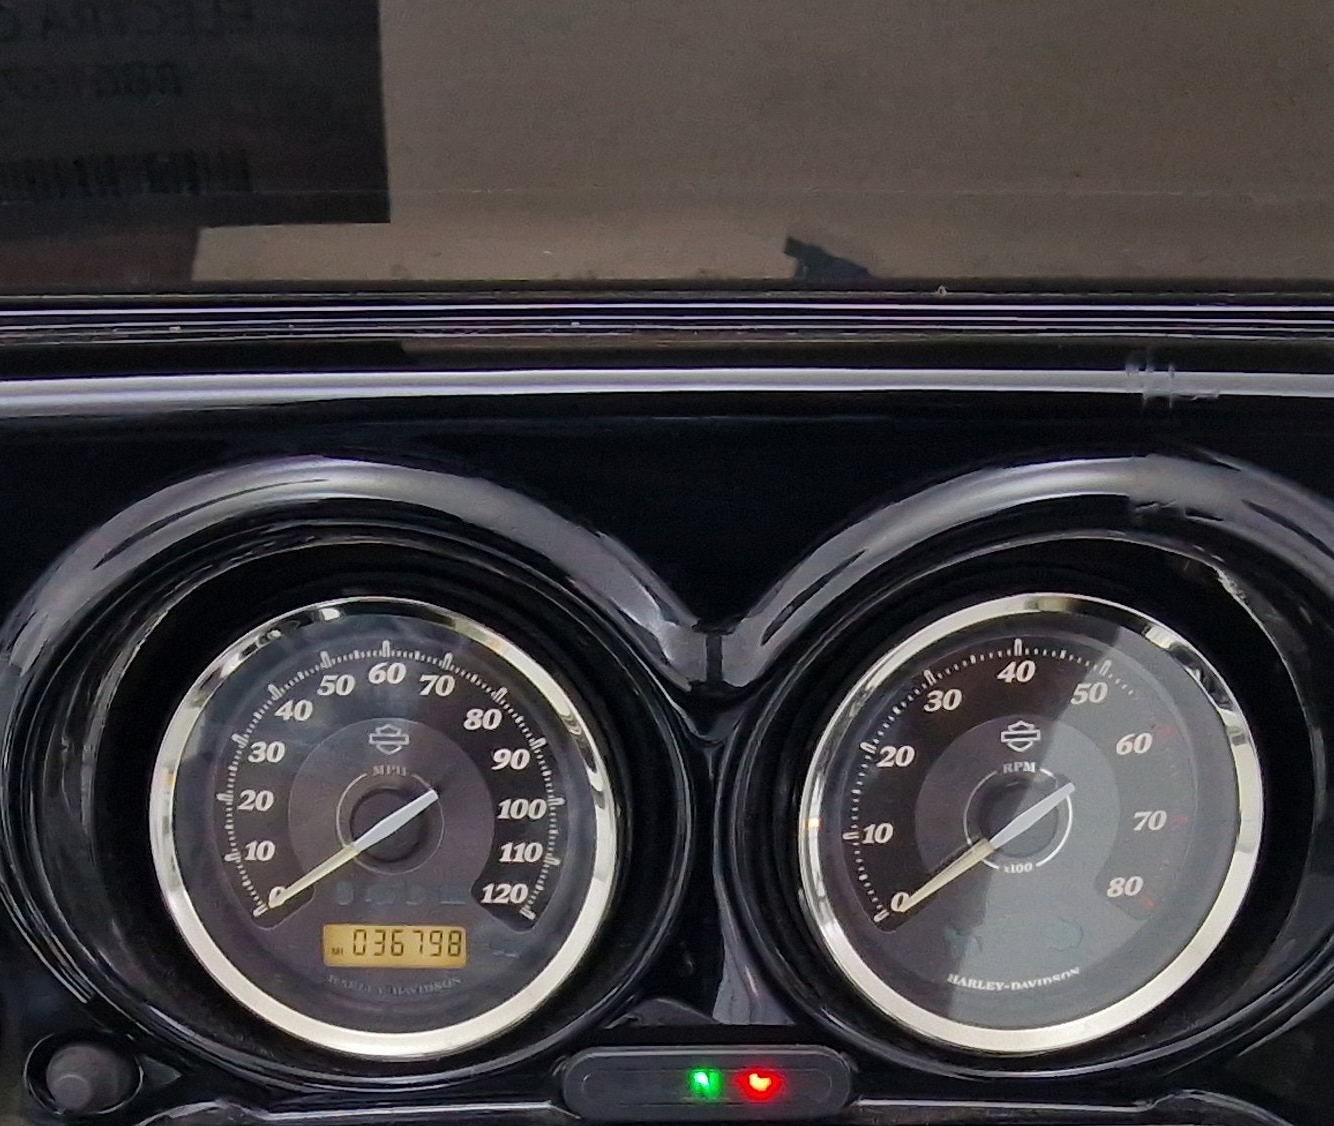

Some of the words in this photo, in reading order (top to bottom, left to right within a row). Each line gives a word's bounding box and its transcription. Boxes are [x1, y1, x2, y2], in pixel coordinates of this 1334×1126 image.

[369, 662, 406, 684] 60
[997, 661, 1036, 682] 40
[317, 675, 354, 697] 50
[419, 675, 455, 697] 70
[1070, 682, 1108, 704] 50
[275, 701, 313, 721] 40
[923, 690, 963, 711] 30
[463, 709, 502, 730] 80
[248, 742, 285, 762] 30
[1115, 733, 1153, 755] 60
[491, 749, 530, 770] 90
[875, 746, 915, 767] 20
[372, 764, 408, 777] MPH
[1002, 761, 1036, 774] RPM
[237, 791, 274, 812] 20
[497, 800, 547, 820] 100
[1132, 811, 1167, 831] 70
[862, 824, 894, 844] 10
[244, 842, 275, 861] 10
[499, 843, 544, 863] 110
[1003, 862, 1033, 873] x100
[480, 884, 529, 904] 120
[1106, 876, 1143, 898] 80
[352, 929, 462, 957] 036798
[947, 966, 1081, 991] HARLEY-DAVIDSON
